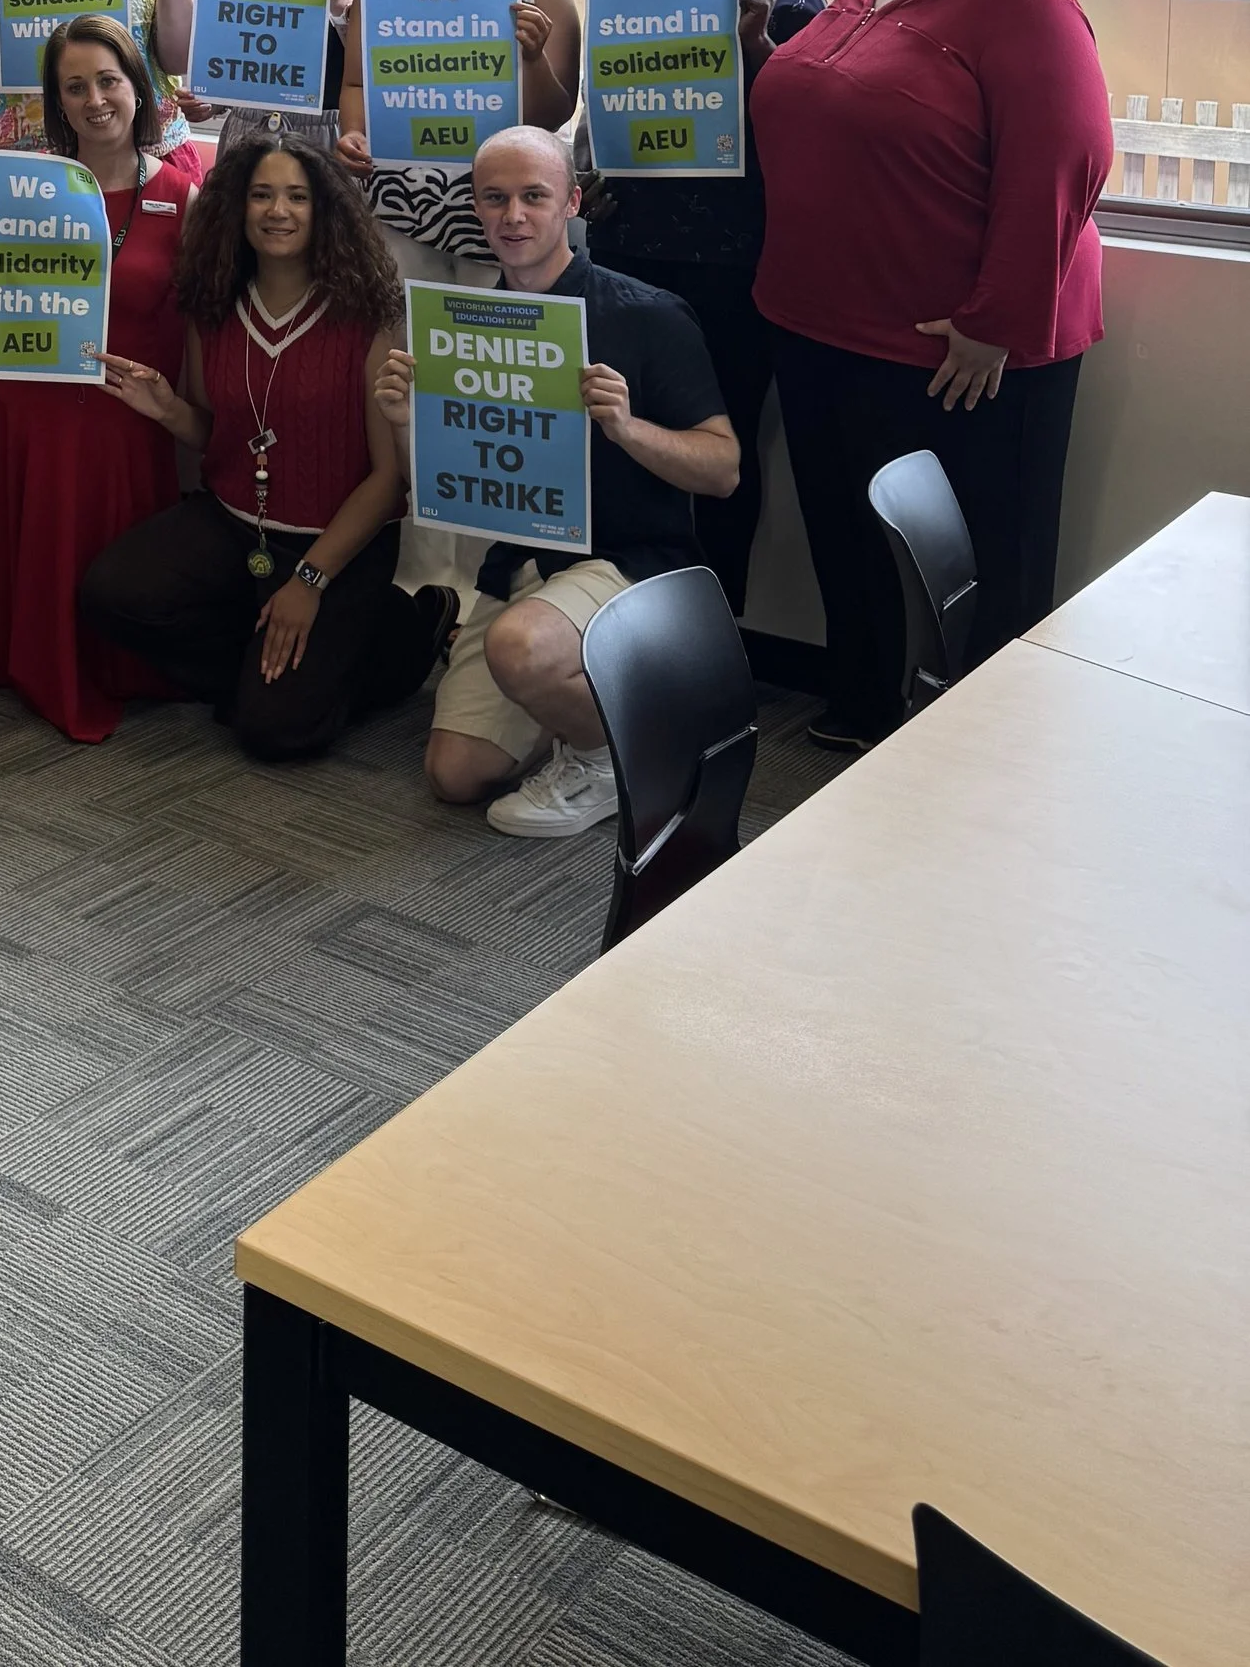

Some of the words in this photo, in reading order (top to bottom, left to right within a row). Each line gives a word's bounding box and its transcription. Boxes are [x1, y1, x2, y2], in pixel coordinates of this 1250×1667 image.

[218, 1, 304, 28] RIGHT
[378, 16, 464, 38] stand
[471, 14, 498, 37] in
[600, 10, 682, 35] stand
[690, 7, 719, 32] in
[240, 32, 277, 55] TO
[208, 58, 305, 87] STRIKE
[379, 51, 505, 76] solidarity
[600, 47, 726, 76] solidarity
[382, 86, 446, 110] with
[453, 89, 503, 111] the
[602, 87, 666, 112] with
[673, 87, 723, 110] the
[419, 127, 468, 145] AEU
[638, 128, 688, 151] AEU
[9, 176, 56, 198] We
[64, 215, 90, 240] in
[113, 229, 127, 247] IEU
[40, 292, 90, 315] the
[447, 301, 492, 312] VICTORIAN
[494, 305, 538, 316] CATHOLIC
[456, 313, 505, 324] EDUCATION
[506, 318, 532, 327] STAFF
[3, 333, 52, 353] AEU
[430, 328, 564, 368] DENIED
[454, 368, 534, 402] OUR
[444, 400, 557, 440] RIGHT
[473, 441, 523, 472] TO
[437, 472, 564, 516] STRIKE
